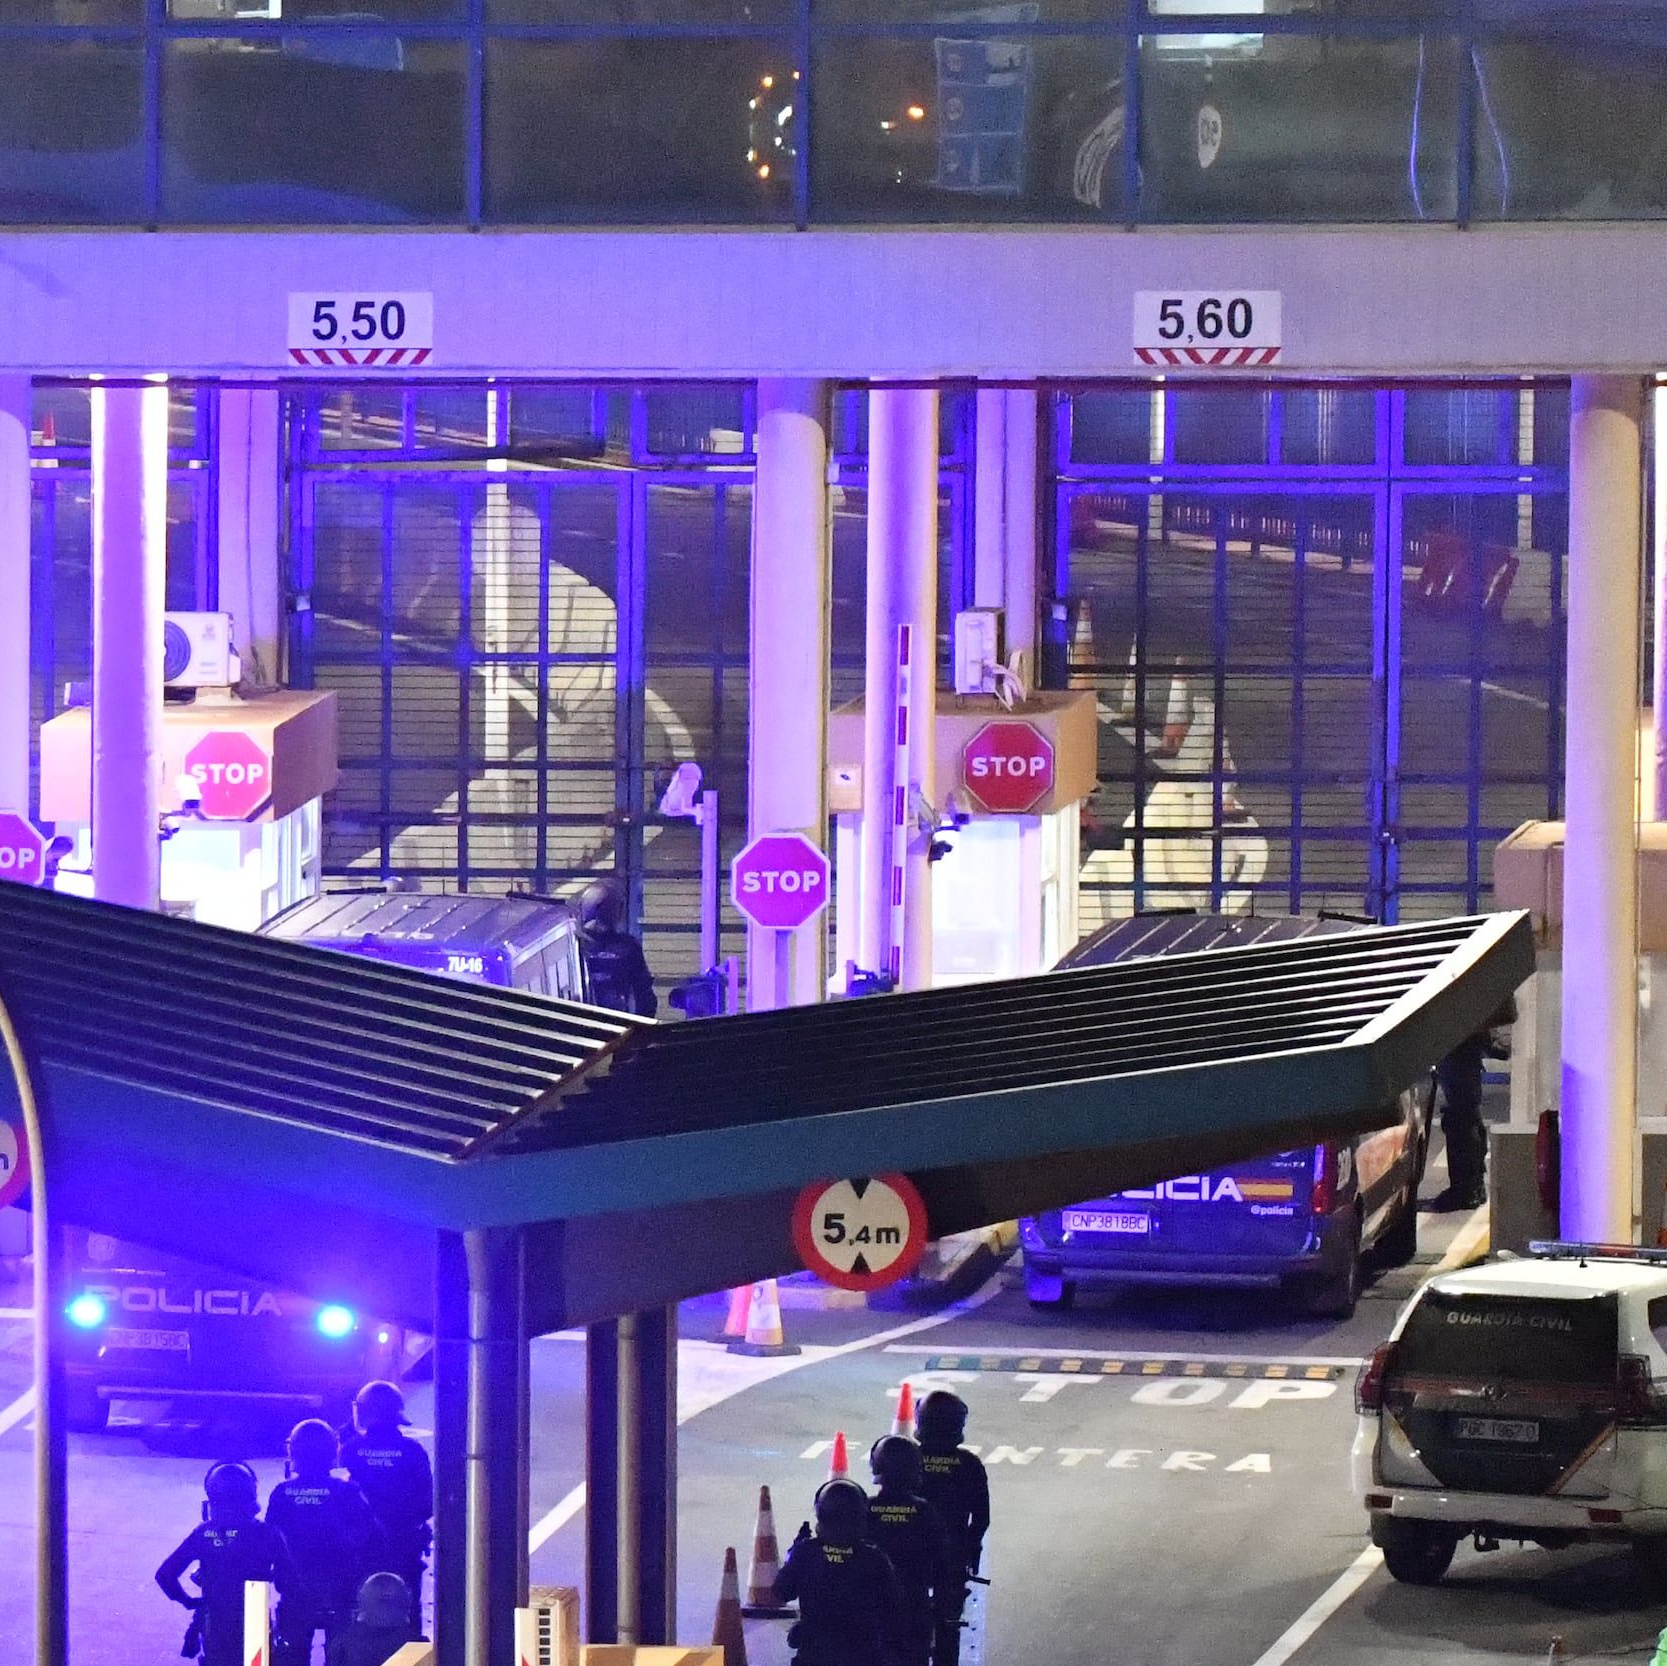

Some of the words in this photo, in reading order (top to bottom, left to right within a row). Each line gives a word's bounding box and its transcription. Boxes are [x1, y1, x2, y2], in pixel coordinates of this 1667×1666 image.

[312, 299, 405, 344] 5,50
[1158, 297, 1253, 343] 5,60
[190, 763, 264, 785] STOP
[971, 756, 1046, 777] STOP
[742, 870, 820, 893] STOP
[885, 1370, 1338, 1408] STOP
